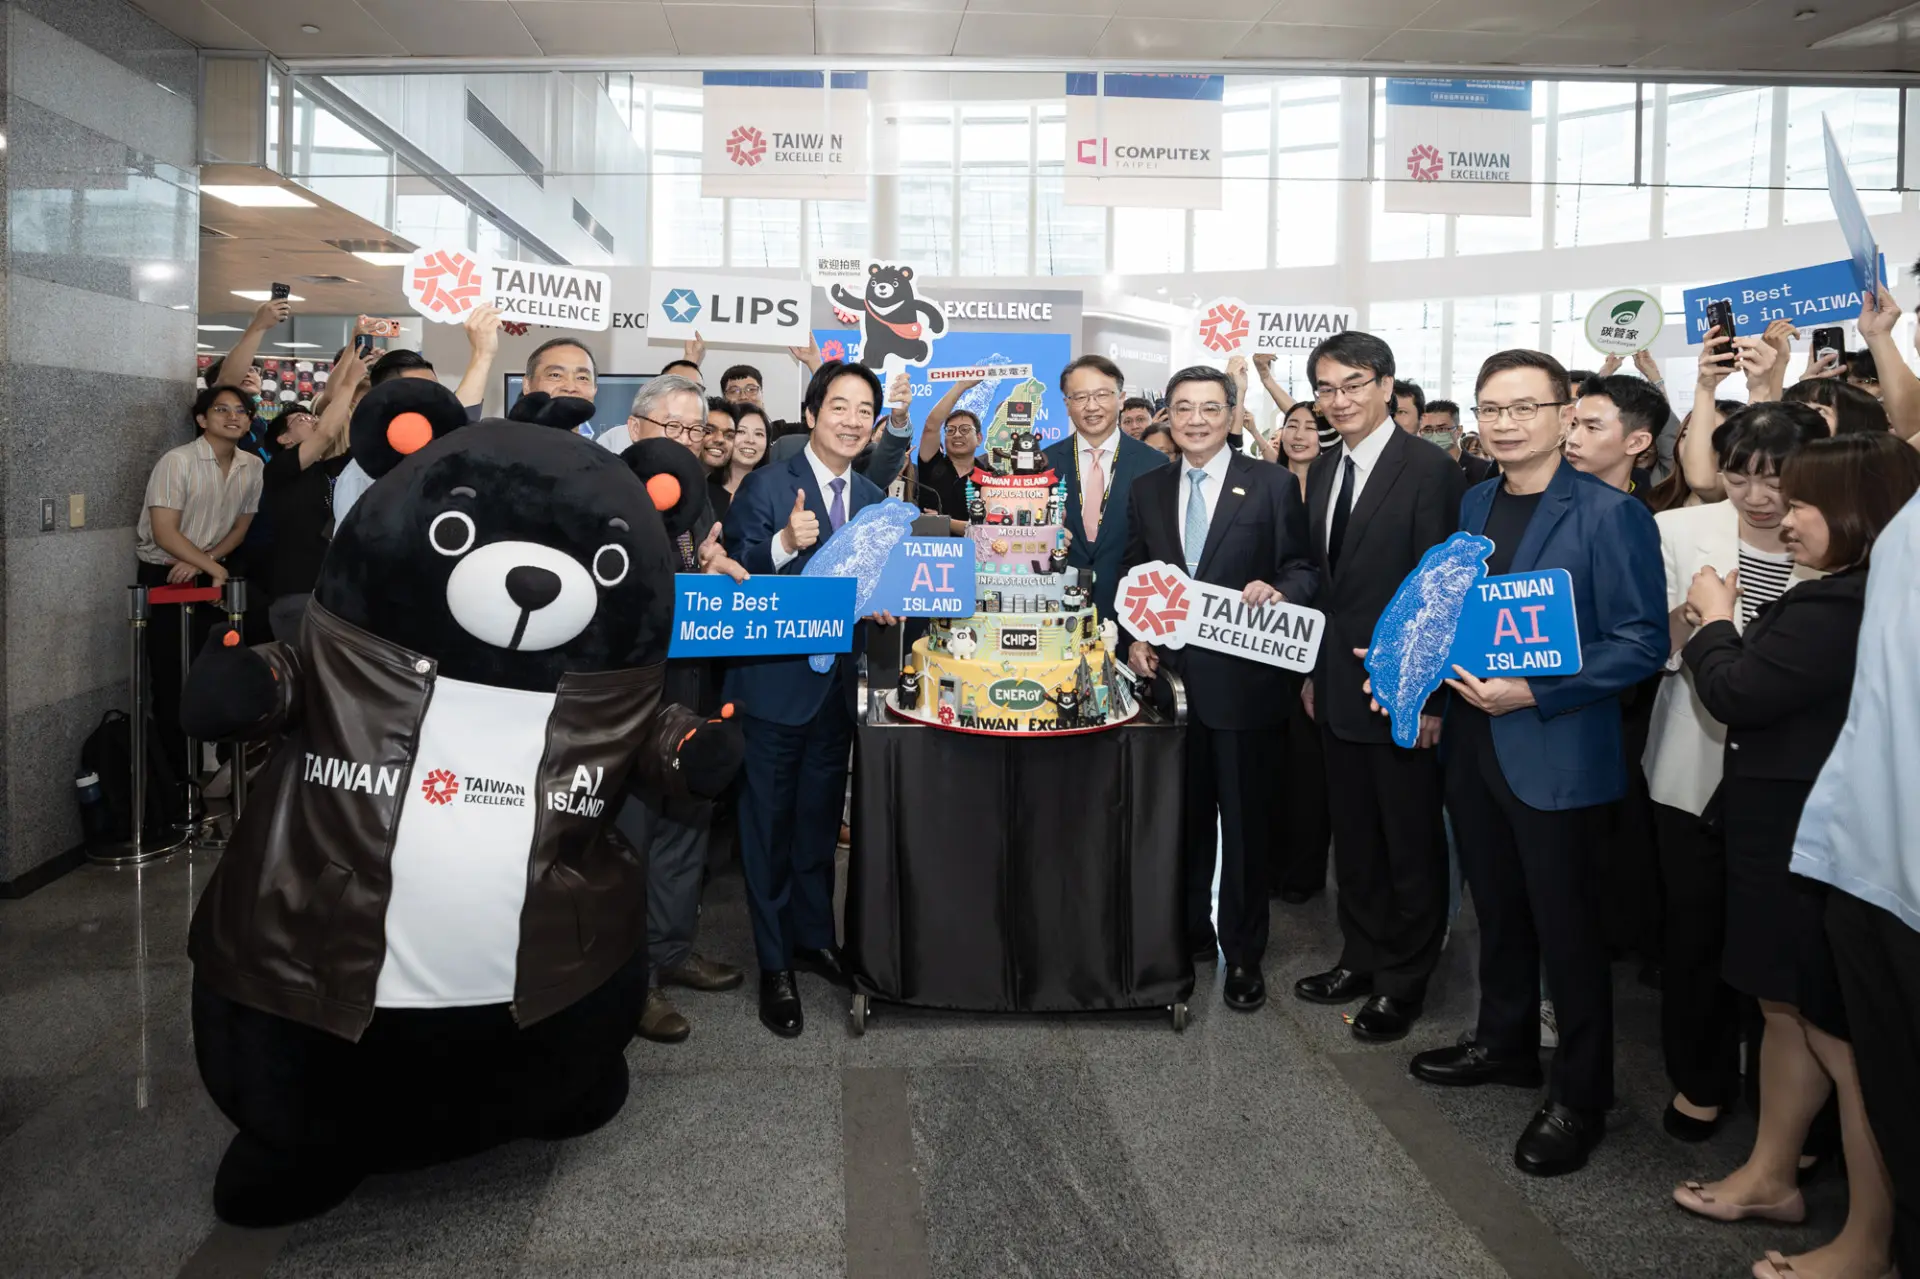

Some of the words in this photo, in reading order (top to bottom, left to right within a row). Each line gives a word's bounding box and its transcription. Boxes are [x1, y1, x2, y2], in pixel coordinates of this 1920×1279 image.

[1114, 146, 1211, 161] COMPUTEX
[1448, 151, 1510, 168] TAIWAN
[1115, 160, 1158, 169] TAIPEI
[1450, 169, 1510, 181] EXCELLENCE
[819, 259, 861, 270] 歡迎拍照
[492, 267, 602, 303] TAIWAN
[1742, 283, 1793, 305] Best
[495, 296, 600, 323] EXCELLENCE
[710, 294, 800, 327] LIPS
[944, 301, 1053, 320] EXCELLENCE
[1760, 307, 1785, 321] in
[1258, 312, 1349, 333] TAIWAN
[1258, 335, 1328, 349] EXCELLEN
[1600, 326, 1639, 340] 碳管家
[930, 369, 986, 379] CHIAYO
[988, 367, 1029, 376] 嘉友電子
[911, 383, 933, 397] 026
[982, 474, 1010, 486] TAIWAN
[1012, 476, 1022, 486] AI
[1024, 476, 1049, 486] ISLAND
[998, 527, 1037, 536] MODELS
[903, 542, 963, 558] TAIWAN
[910, 563, 955, 593] AI
[1478, 577, 1554, 602] TAIWAN
[684, 592, 723, 612] The
[732, 592, 780, 611] Best
[902, 597, 962, 612] ISLAND
[1201, 592, 1315, 643] TAIWAN
[1493, 605, 1549, 646] AI
[680, 620, 735, 641] Made
[744, 620, 768, 640] in
[774, 619, 844, 639] TAIWAN
[1003, 635, 1037, 647] CHIPS
[1198, 623, 1308, 664] EXCELLENCE
[1485, 650, 1562, 671] ISLAND
[995, 688, 1042, 701] ENERGY
[958, 715, 1019, 731] TAIWAN
[304, 752, 400, 797] TAIWAN
[569, 764, 604, 796] AI
[464, 777, 526, 796] TAIWAN
[464, 794, 525, 807] EXCELLENCE
[547, 791, 605, 818] ISLAND
